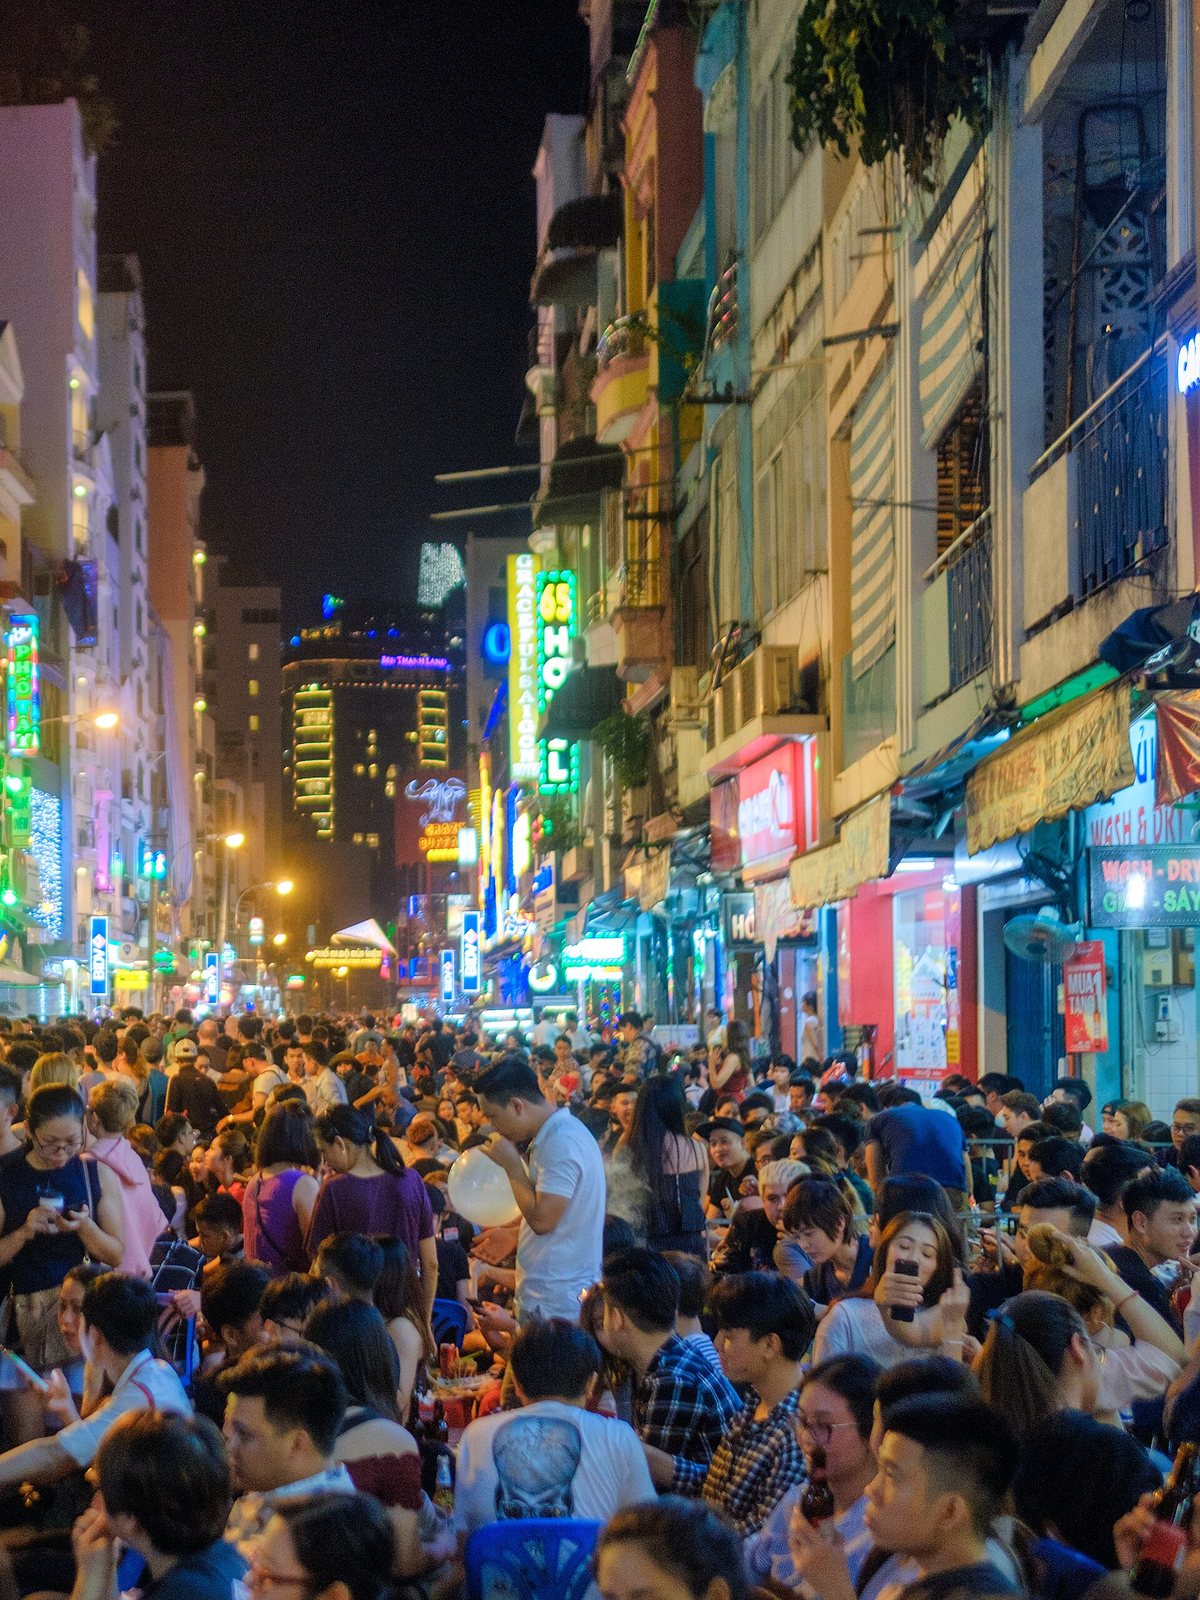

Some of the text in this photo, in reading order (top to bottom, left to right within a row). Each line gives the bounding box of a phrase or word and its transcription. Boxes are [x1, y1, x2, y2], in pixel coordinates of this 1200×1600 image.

[540, 583, 571, 623] 65
[516, 554, 535, 762] GRACEFUL SAIGON
[543, 625, 570, 782] HOL
[1091, 810, 1132, 846] WASH
[1101, 859, 1153, 882] WASH
[93, 948, 106, 980] BIDV
[464, 943, 478, 978] BIDV
[1067, 972, 1094, 995] MUA
